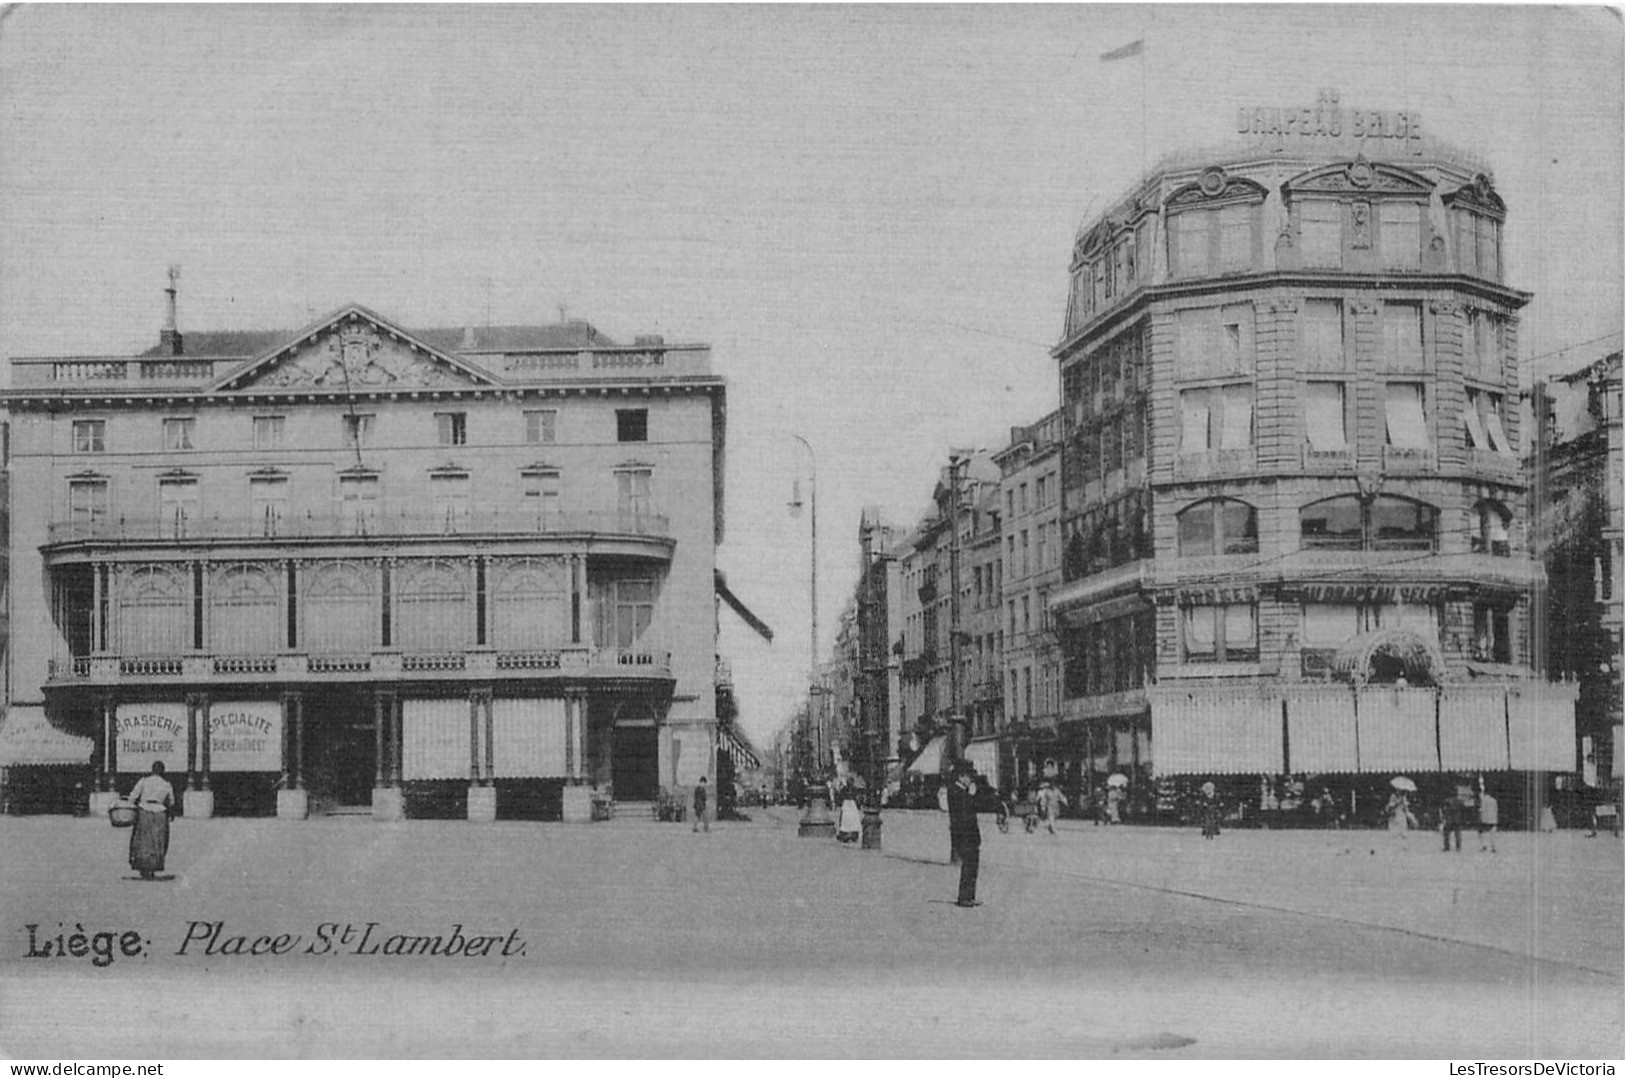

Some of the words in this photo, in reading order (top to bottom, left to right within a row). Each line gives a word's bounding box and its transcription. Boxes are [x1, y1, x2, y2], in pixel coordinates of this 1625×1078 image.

[1237, 106, 1342, 137] DRAPEAU
[1353, 110, 1421, 140] BELGE
[116, 715, 183, 737] BRASSERIE
